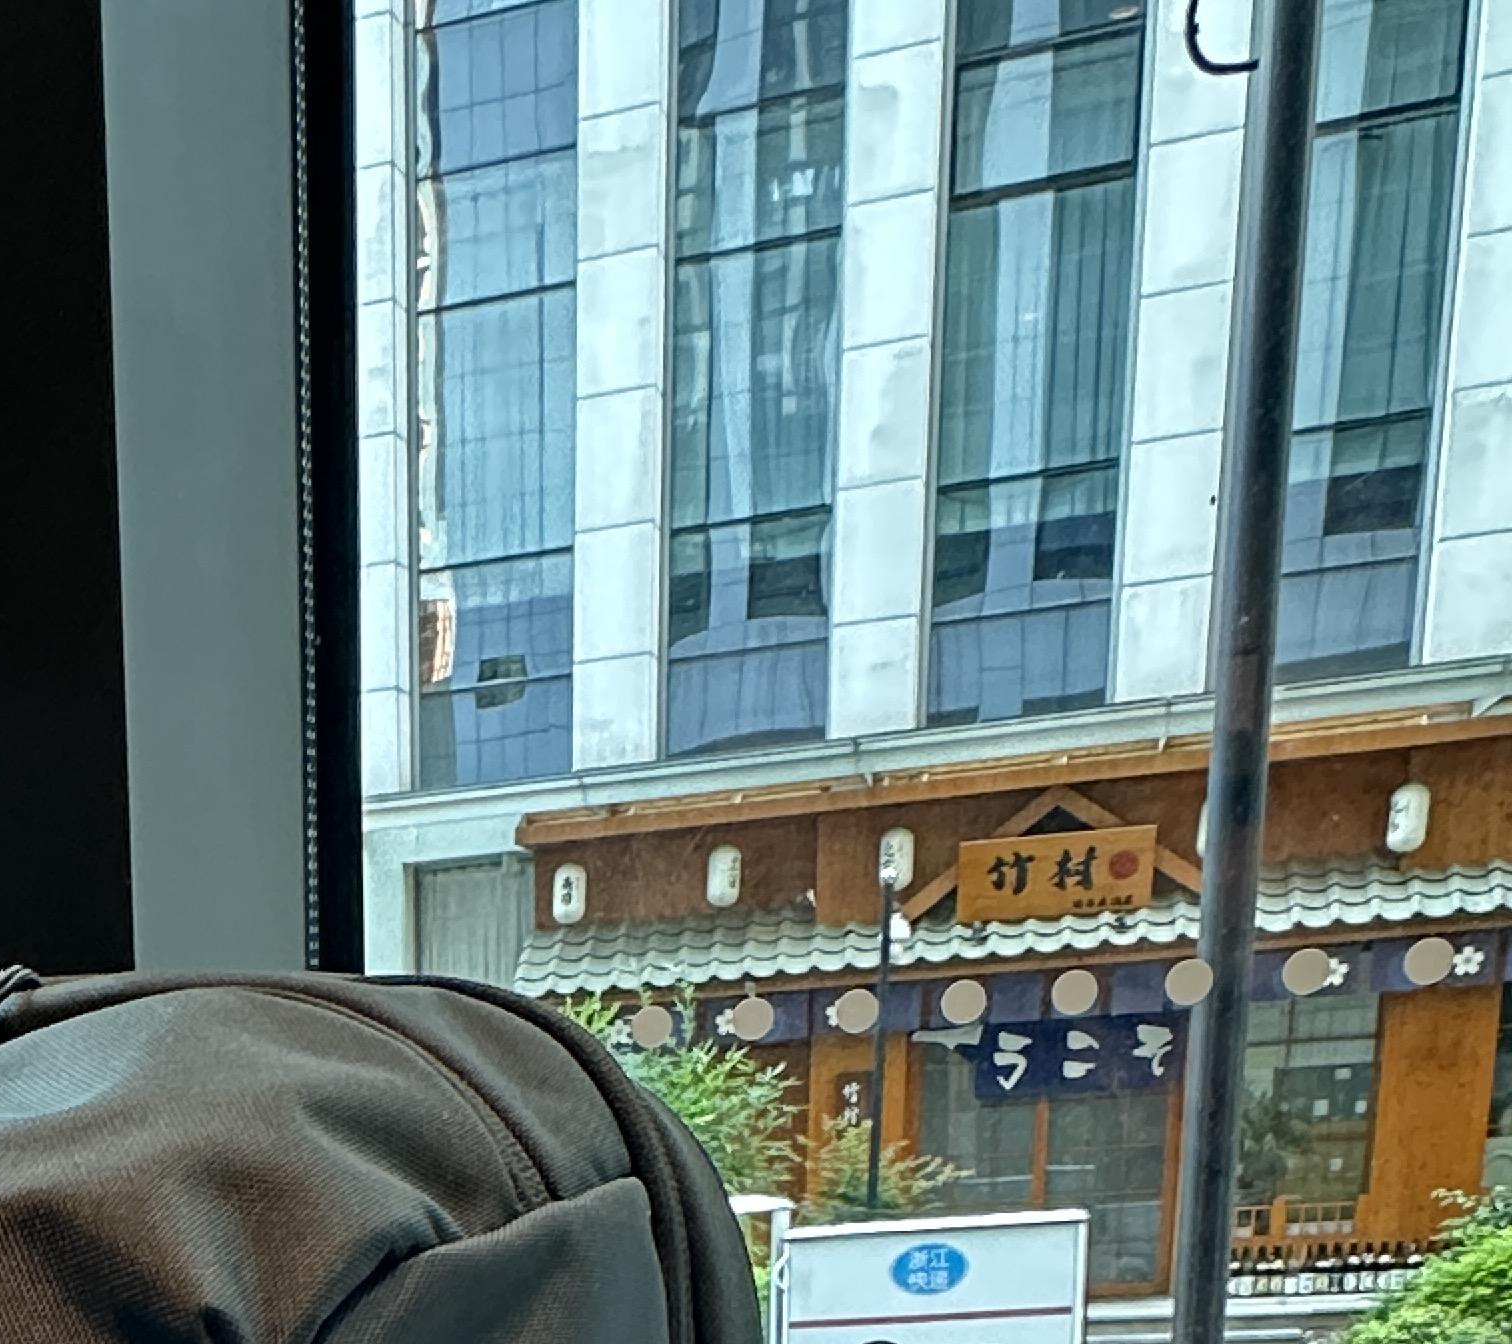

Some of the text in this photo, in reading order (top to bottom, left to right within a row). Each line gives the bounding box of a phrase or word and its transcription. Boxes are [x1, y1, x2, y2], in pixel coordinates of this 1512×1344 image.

[987, 846, 1099, 895] 竹村
[912, 1023, 1174, 1090] うこそ
